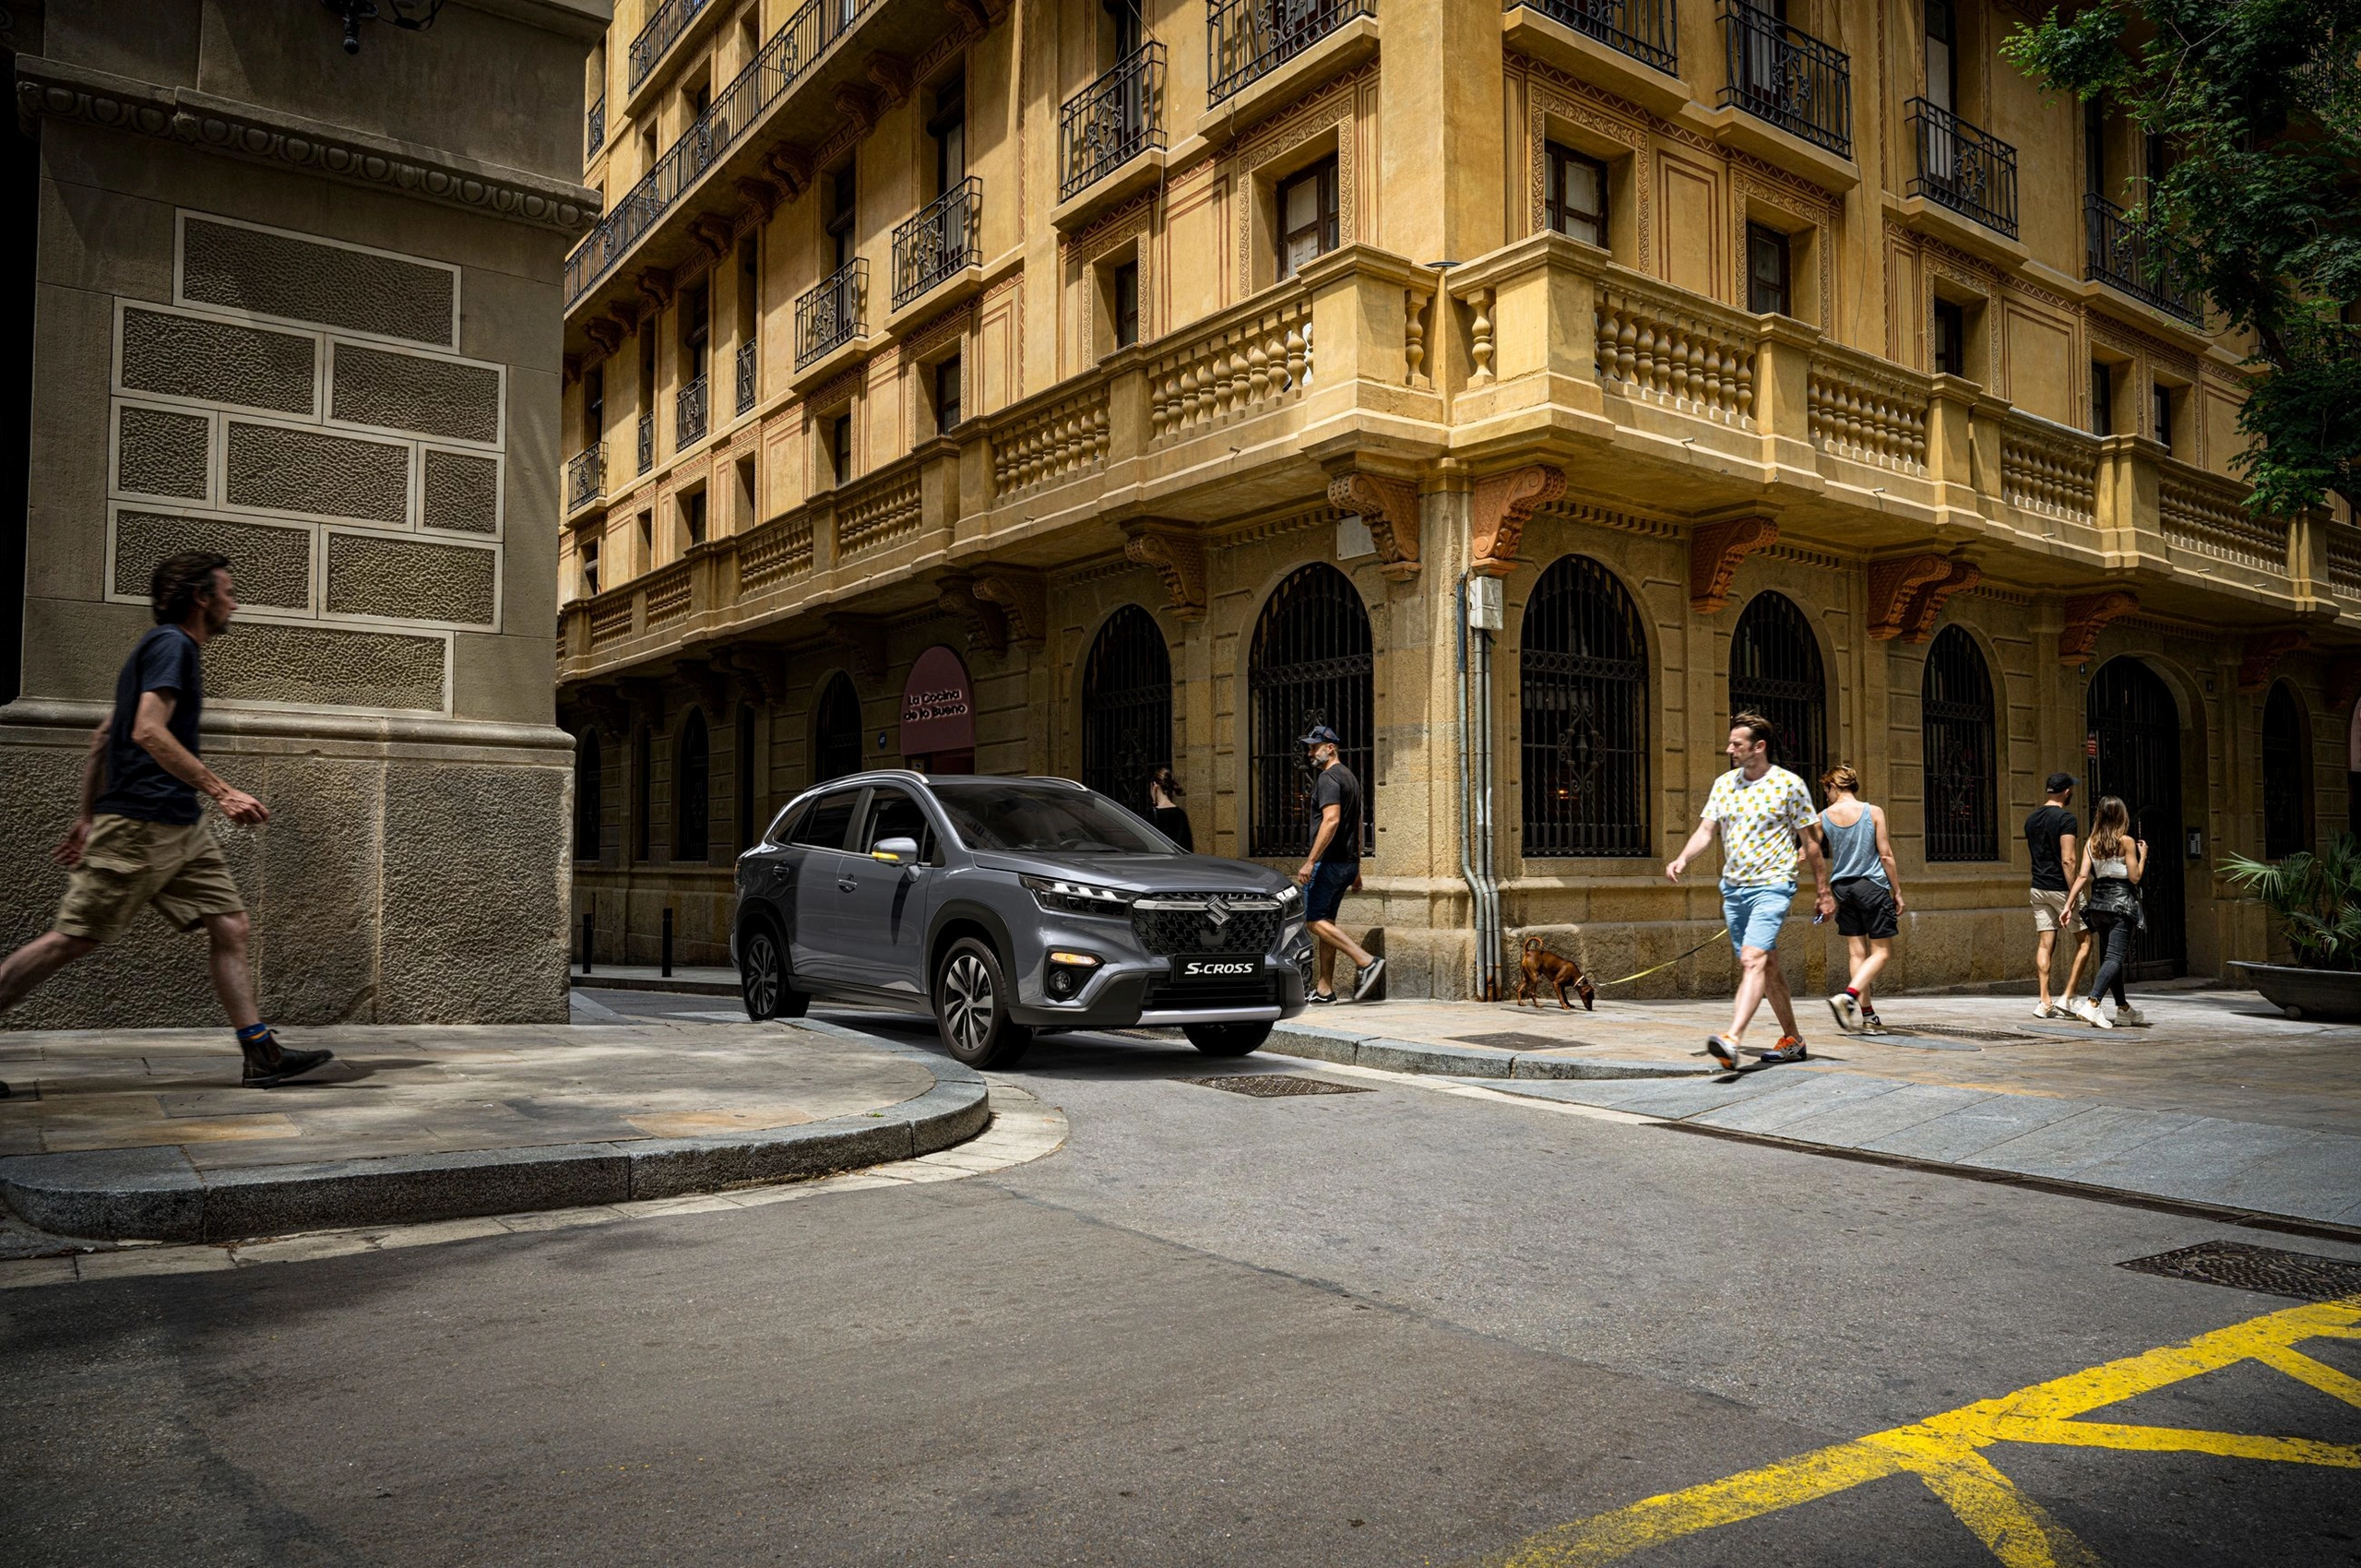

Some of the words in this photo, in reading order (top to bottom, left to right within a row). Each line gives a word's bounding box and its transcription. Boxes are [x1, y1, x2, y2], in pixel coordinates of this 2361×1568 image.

[907, 695, 920, 707] La
[922, 689, 962, 705] Cocina
[903, 710, 919, 722] de
[919, 708, 932, 720] lo
[932, 704, 967, 718] Bueno
